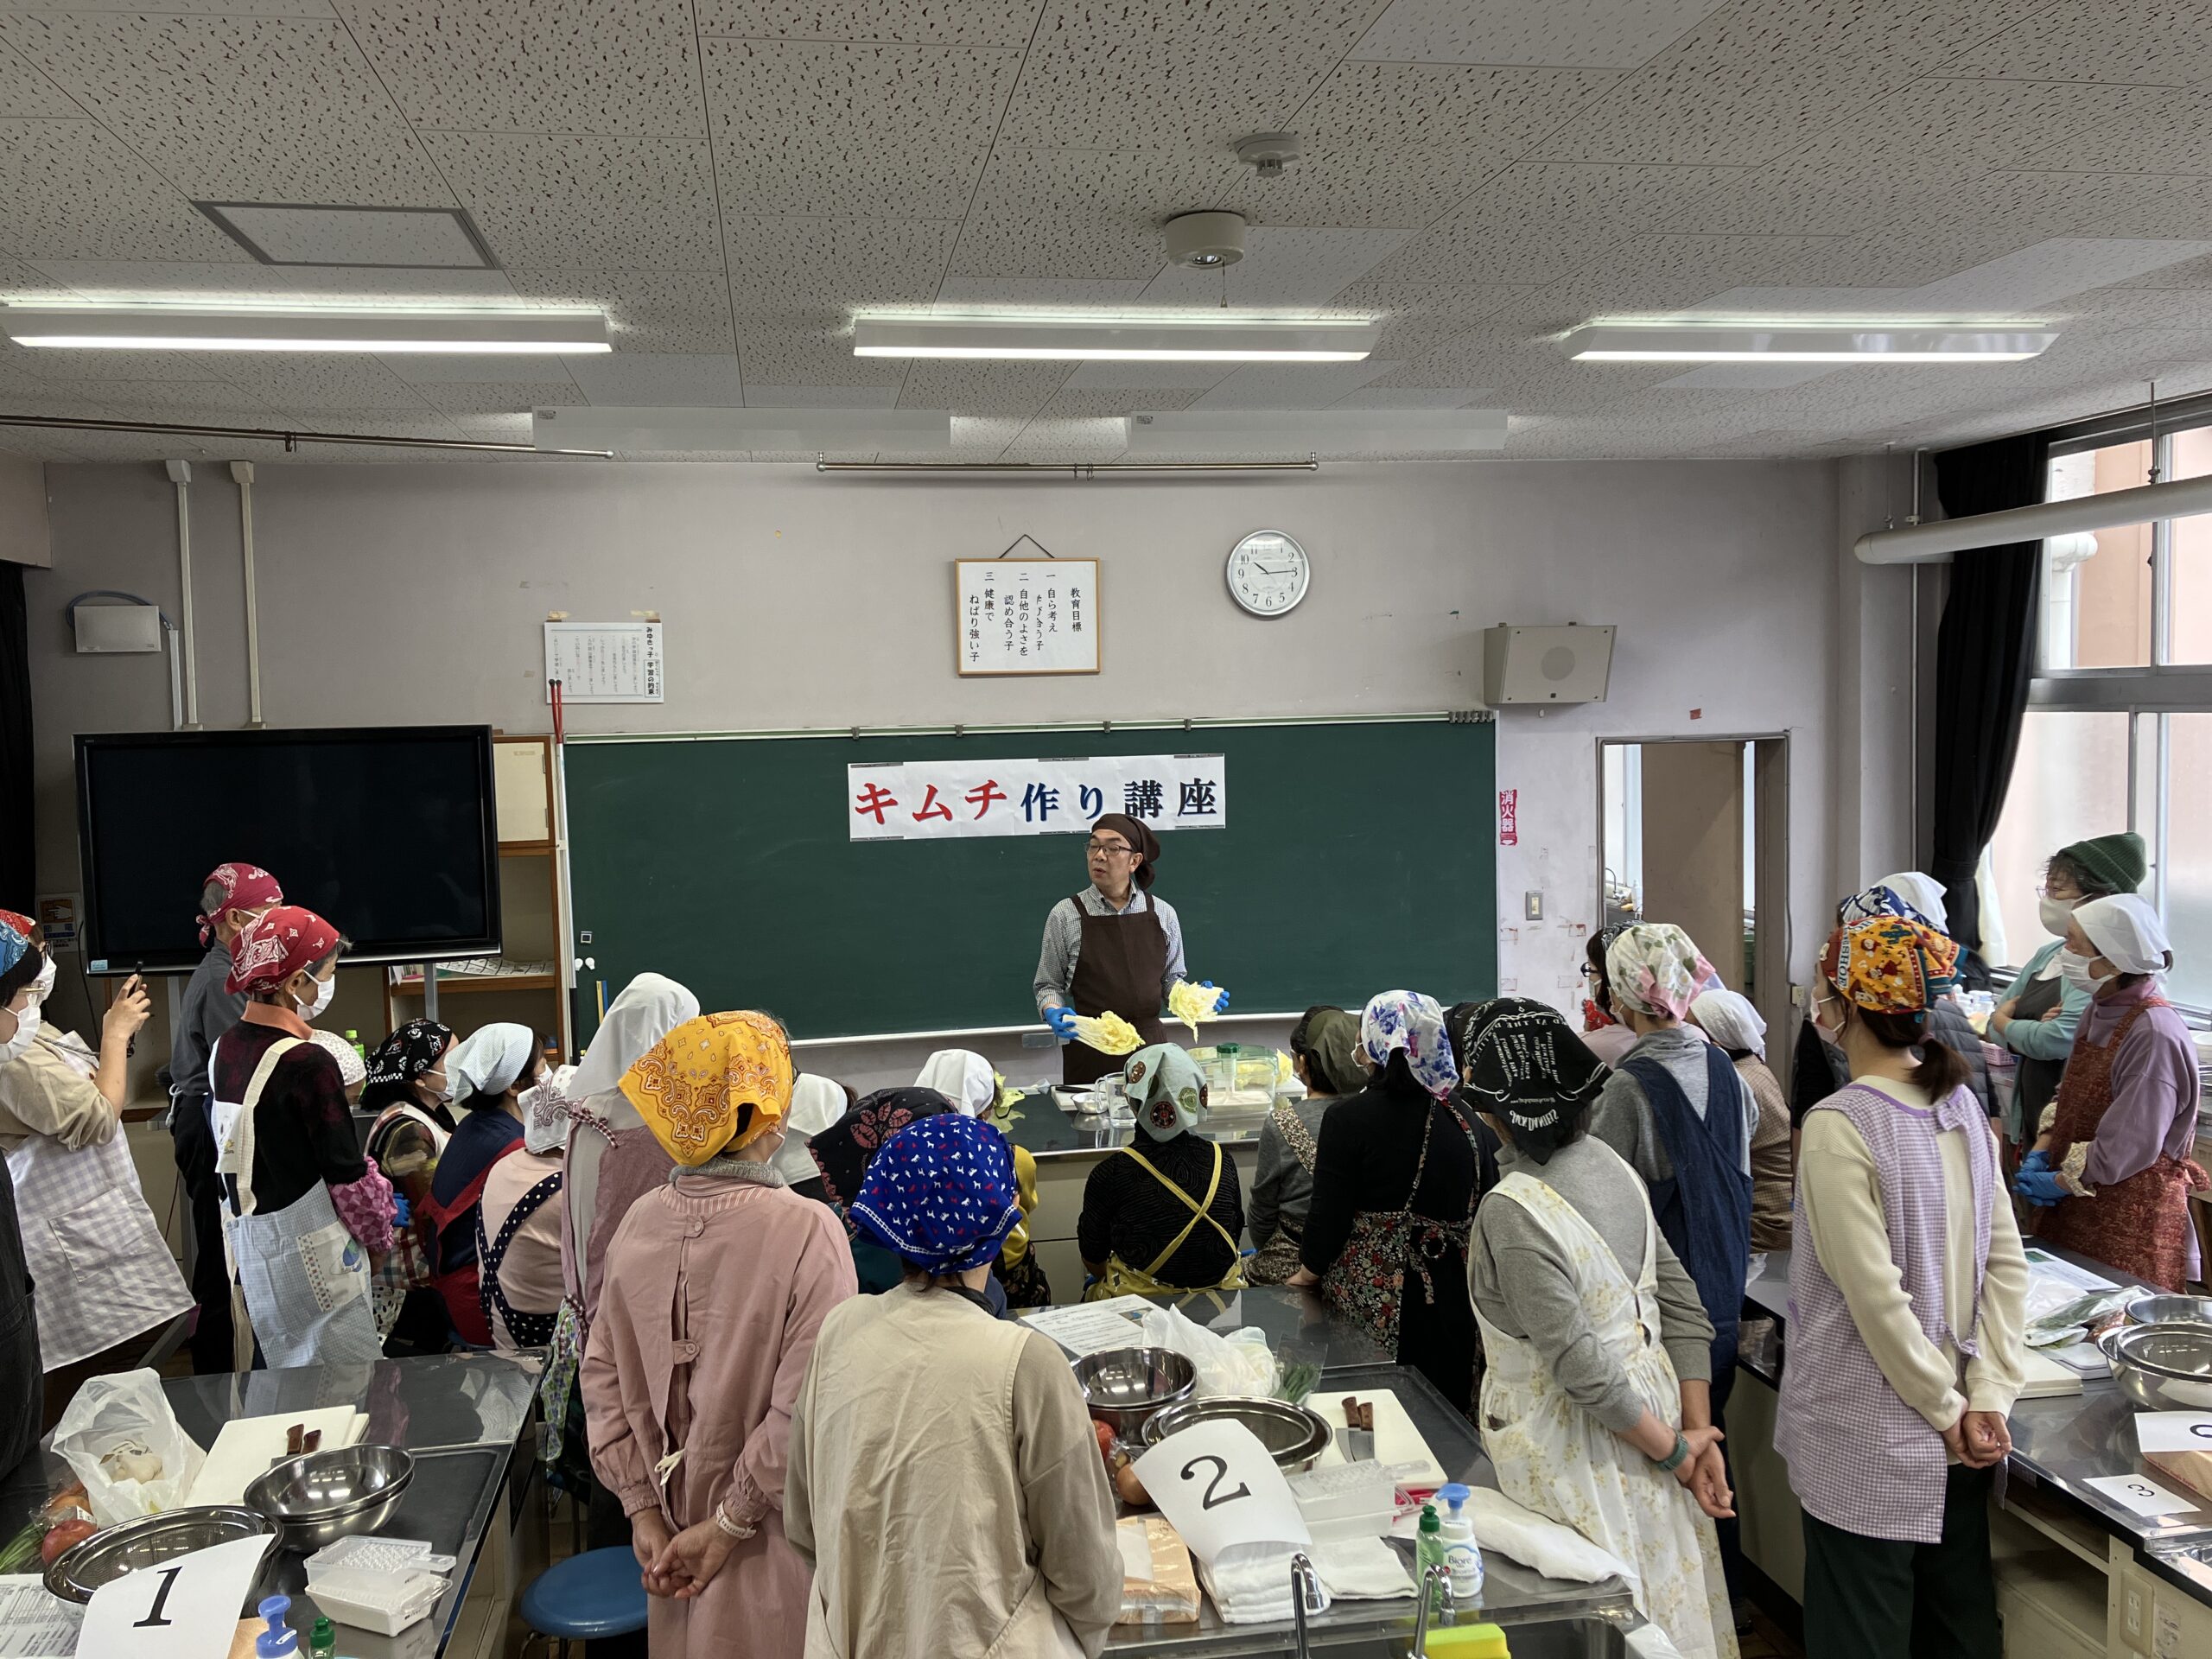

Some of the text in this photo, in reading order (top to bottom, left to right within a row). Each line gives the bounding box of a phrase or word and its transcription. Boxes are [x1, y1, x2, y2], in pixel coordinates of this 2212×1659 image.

[1250, 544, 1257, 555] 11
[1240, 554, 1249, 565] 10
[1287, 552, 1294, 563] 2
[1238, 569, 1244, 579] 9
[1291, 567, 1298, 577] 3
[1242, 582, 1249, 594] 8
[1288, 582, 1294, 592] 4
[984, 571, 995, 621] 三 健康で
[1253, 593, 1259, 604] 7
[1265, 595, 1272, 607] 6
[1279, 592, 1285, 603] 5
[1019, 573, 1029, 657] 二 自他のよさを
[1047, 588, 1058, 632] 自ら考え
[1071, 588, 1082, 632] 教育目標
[969, 594, 980, 662] ねばり強い子
[1004, 594, 1014, 652] 認め合う子
[855, 778, 1217, 825] キムチ作り講座
[1501, 790, 1514, 832] 消火器
[1180, 1455, 1251, 1510] 2
[2127, 1484, 2155, 1497] 3
[132, 1566, 183, 1628] 1
